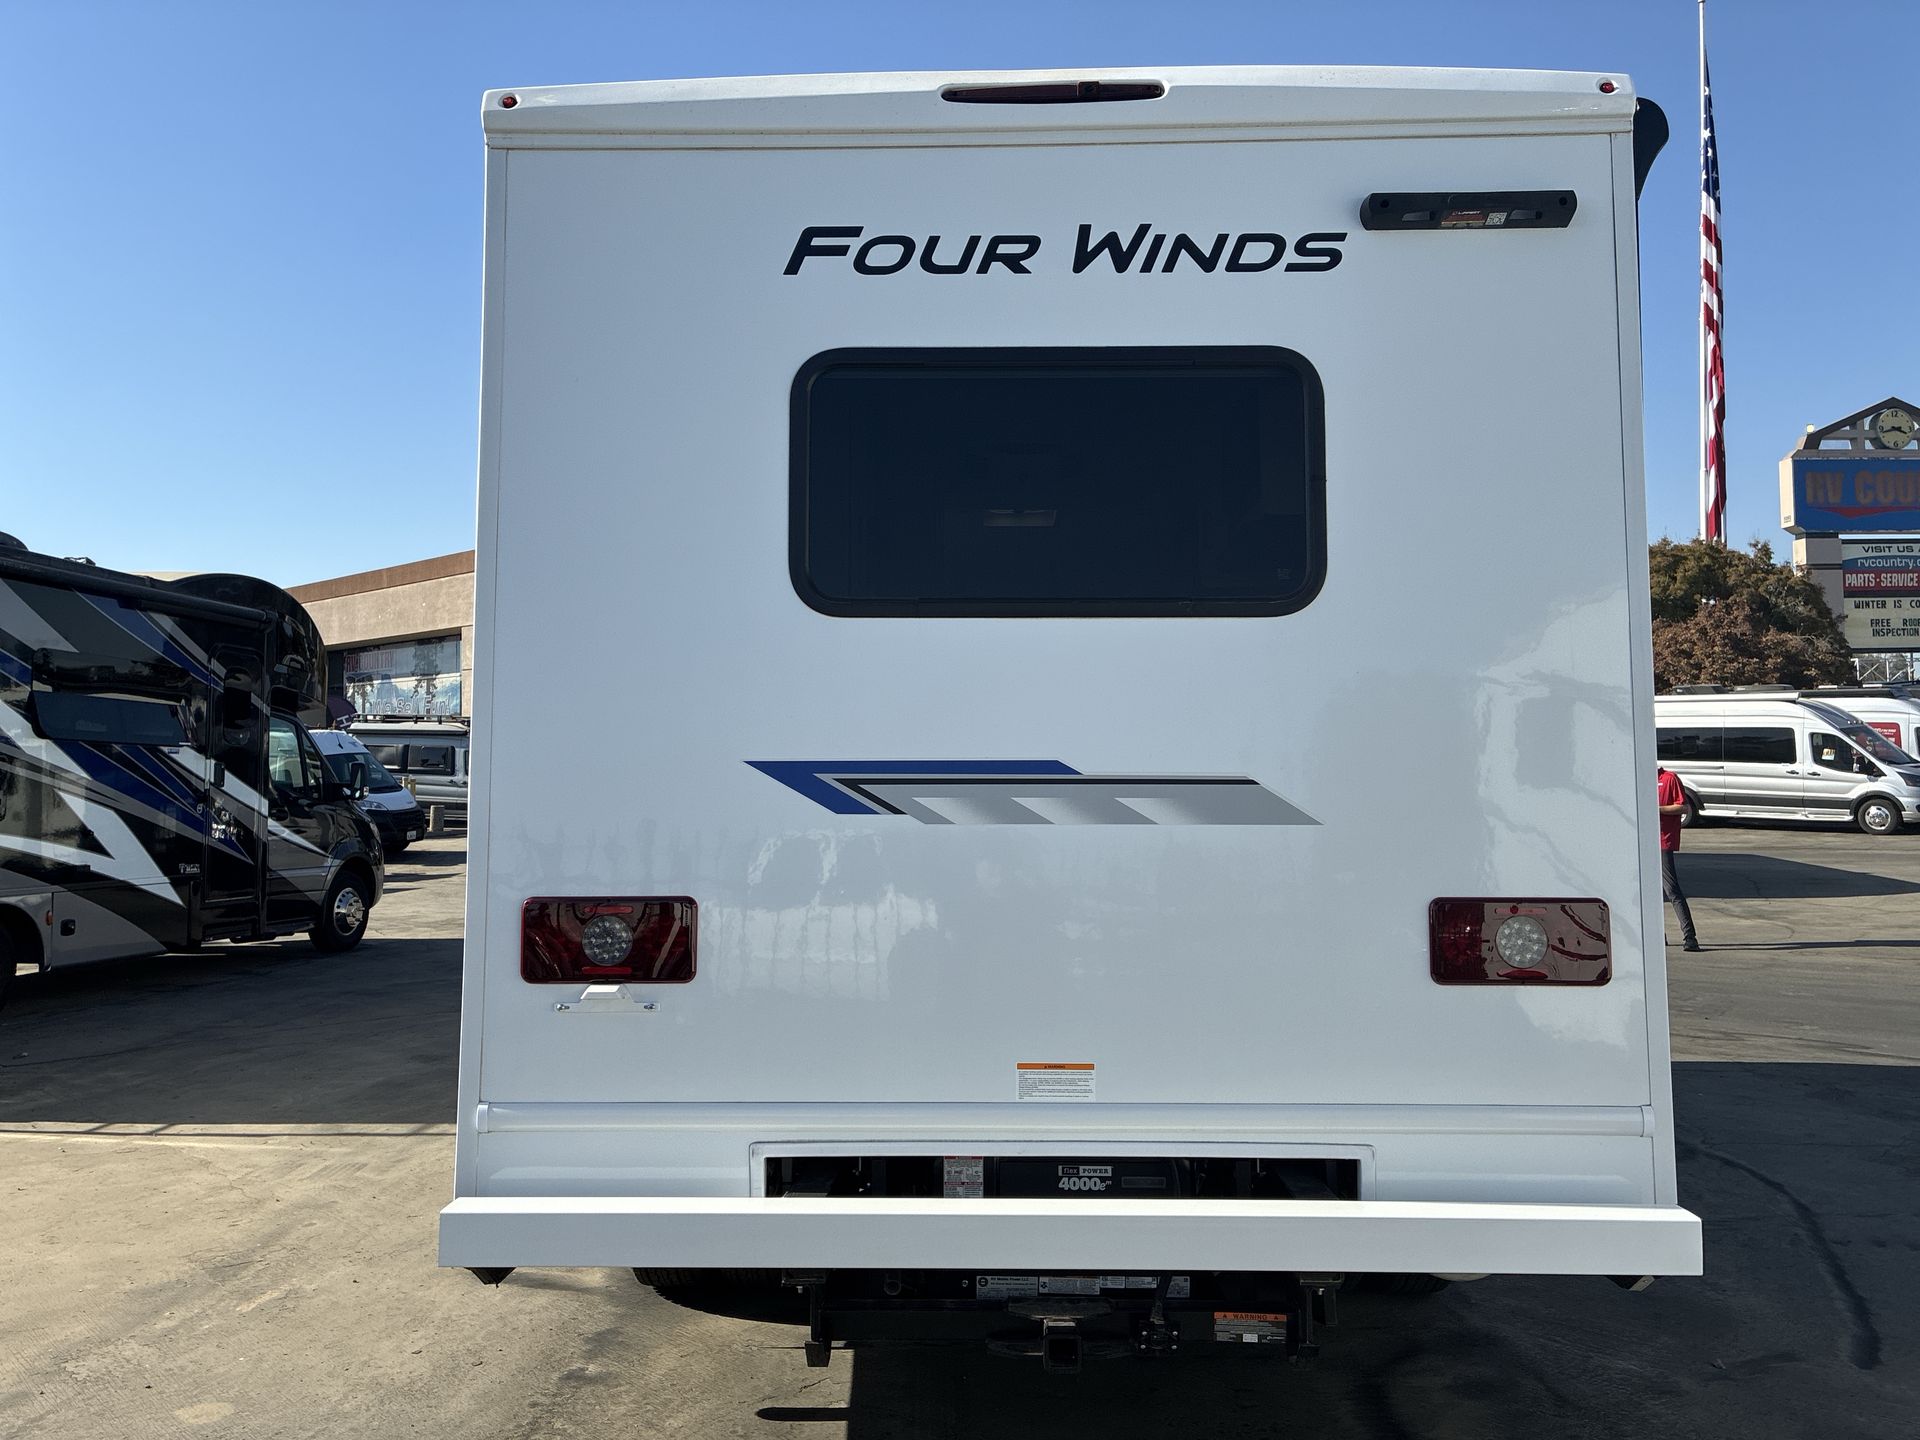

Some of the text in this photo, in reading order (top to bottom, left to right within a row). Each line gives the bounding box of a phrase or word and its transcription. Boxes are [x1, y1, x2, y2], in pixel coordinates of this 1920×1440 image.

[782, 223, 1348, 275] FOUR WINDS
[1891, 410, 1899, 418] 12
[1878, 424, 1884, 432] 9
[1893, 440, 1899, 448] 6
[1806, 469, 1920, 506] RV COU
[1862, 545, 1893, 553] VISIT
[1897, 545, 1914, 553] US
[1845, 573, 1919, 587] PARTS SERVICE
[1854, 600, 1887, 609] WINTER
[1893, 600, 1902, 608] IS
[1870, 619, 1891, 627] FREE
